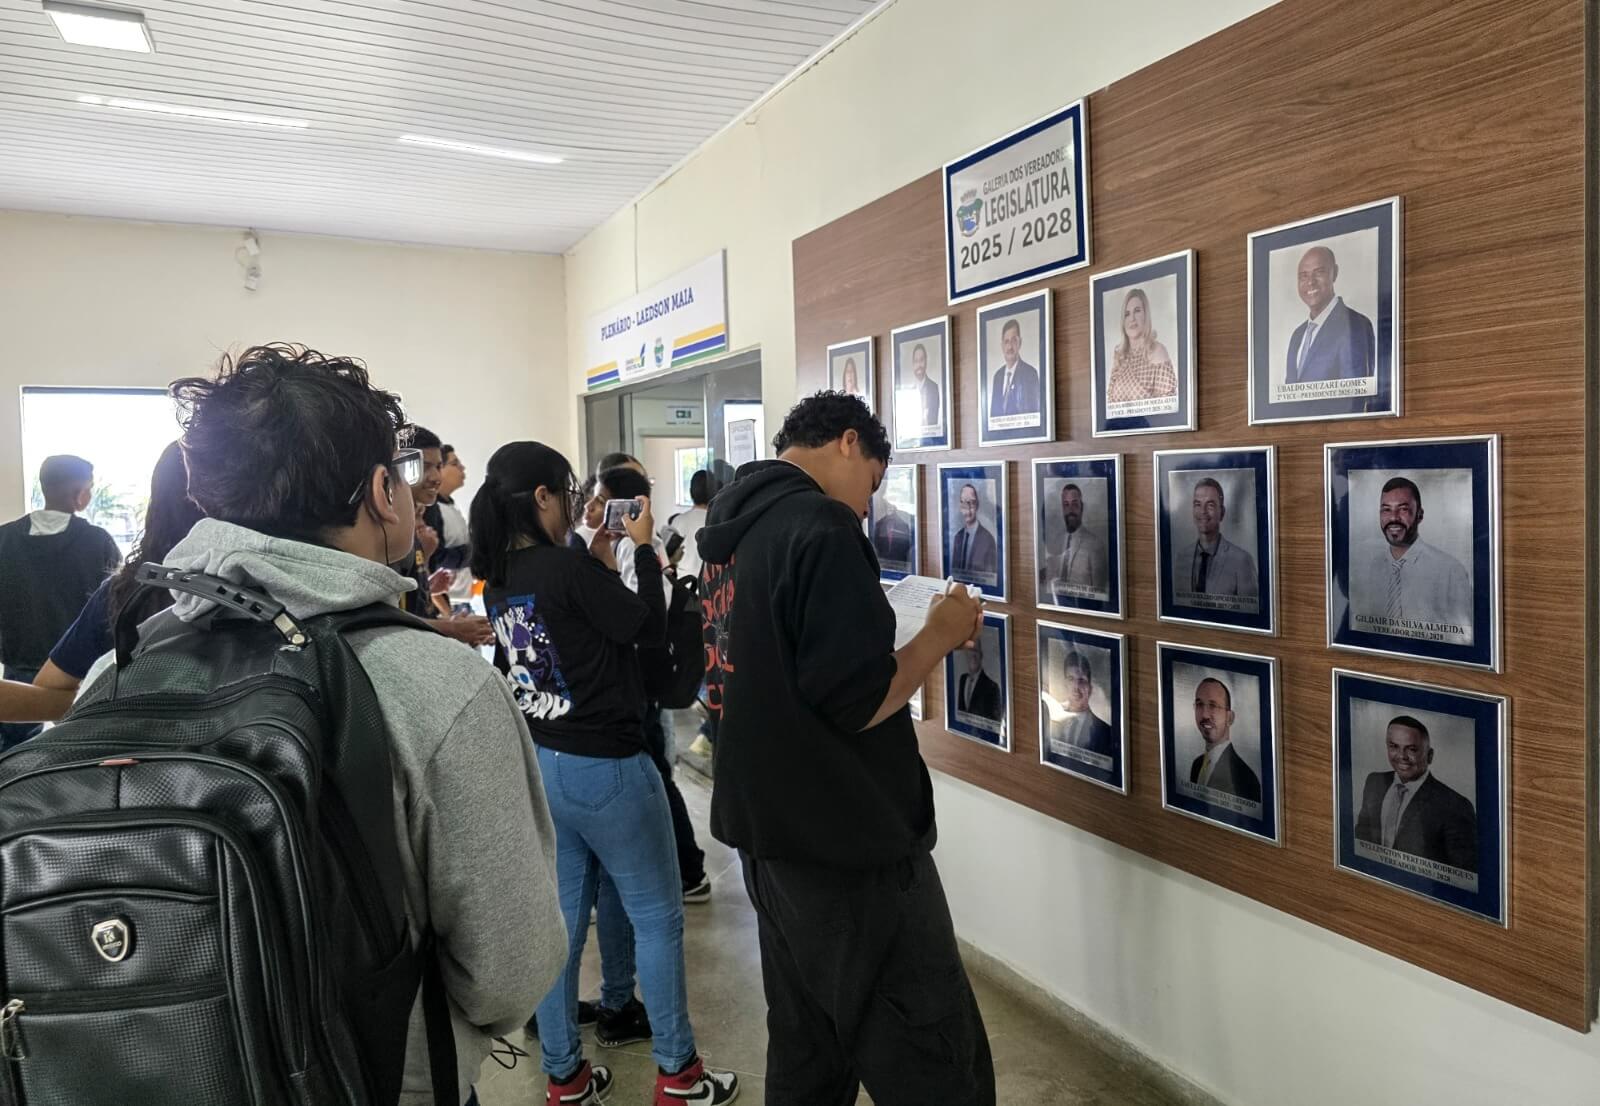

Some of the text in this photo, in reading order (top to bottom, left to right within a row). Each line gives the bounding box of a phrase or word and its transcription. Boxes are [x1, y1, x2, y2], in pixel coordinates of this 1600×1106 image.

[982, 147, 1066, 195] GALERIA DOS VEREADORE
[984, 167, 1071, 228] LEGISLATURA
[960, 207, 1072, 270] 2025 / 2028
[600, 316, 632, 341] PLENÁRIO
[636, 297, 670, 326] LAEDSON
[671, 287, 694, 311] MAIA
[1277, 383, 1305, 394] UBALDO
[1340, 378, 1367, 389] GOMES
[1301, 389, 1336, 399] PRESIDENTE
[1356, 614, 1465, 635] GILDAIR DA SILVA ALMEIDA
[1373, 625, 1410, 637] VEREADOR
[1360, 840, 1401, 858] WELLINGTON
[1432, 858, 1474, 880] RODRIGUES
[1379, 855, 1417, 873] VEREADOR
